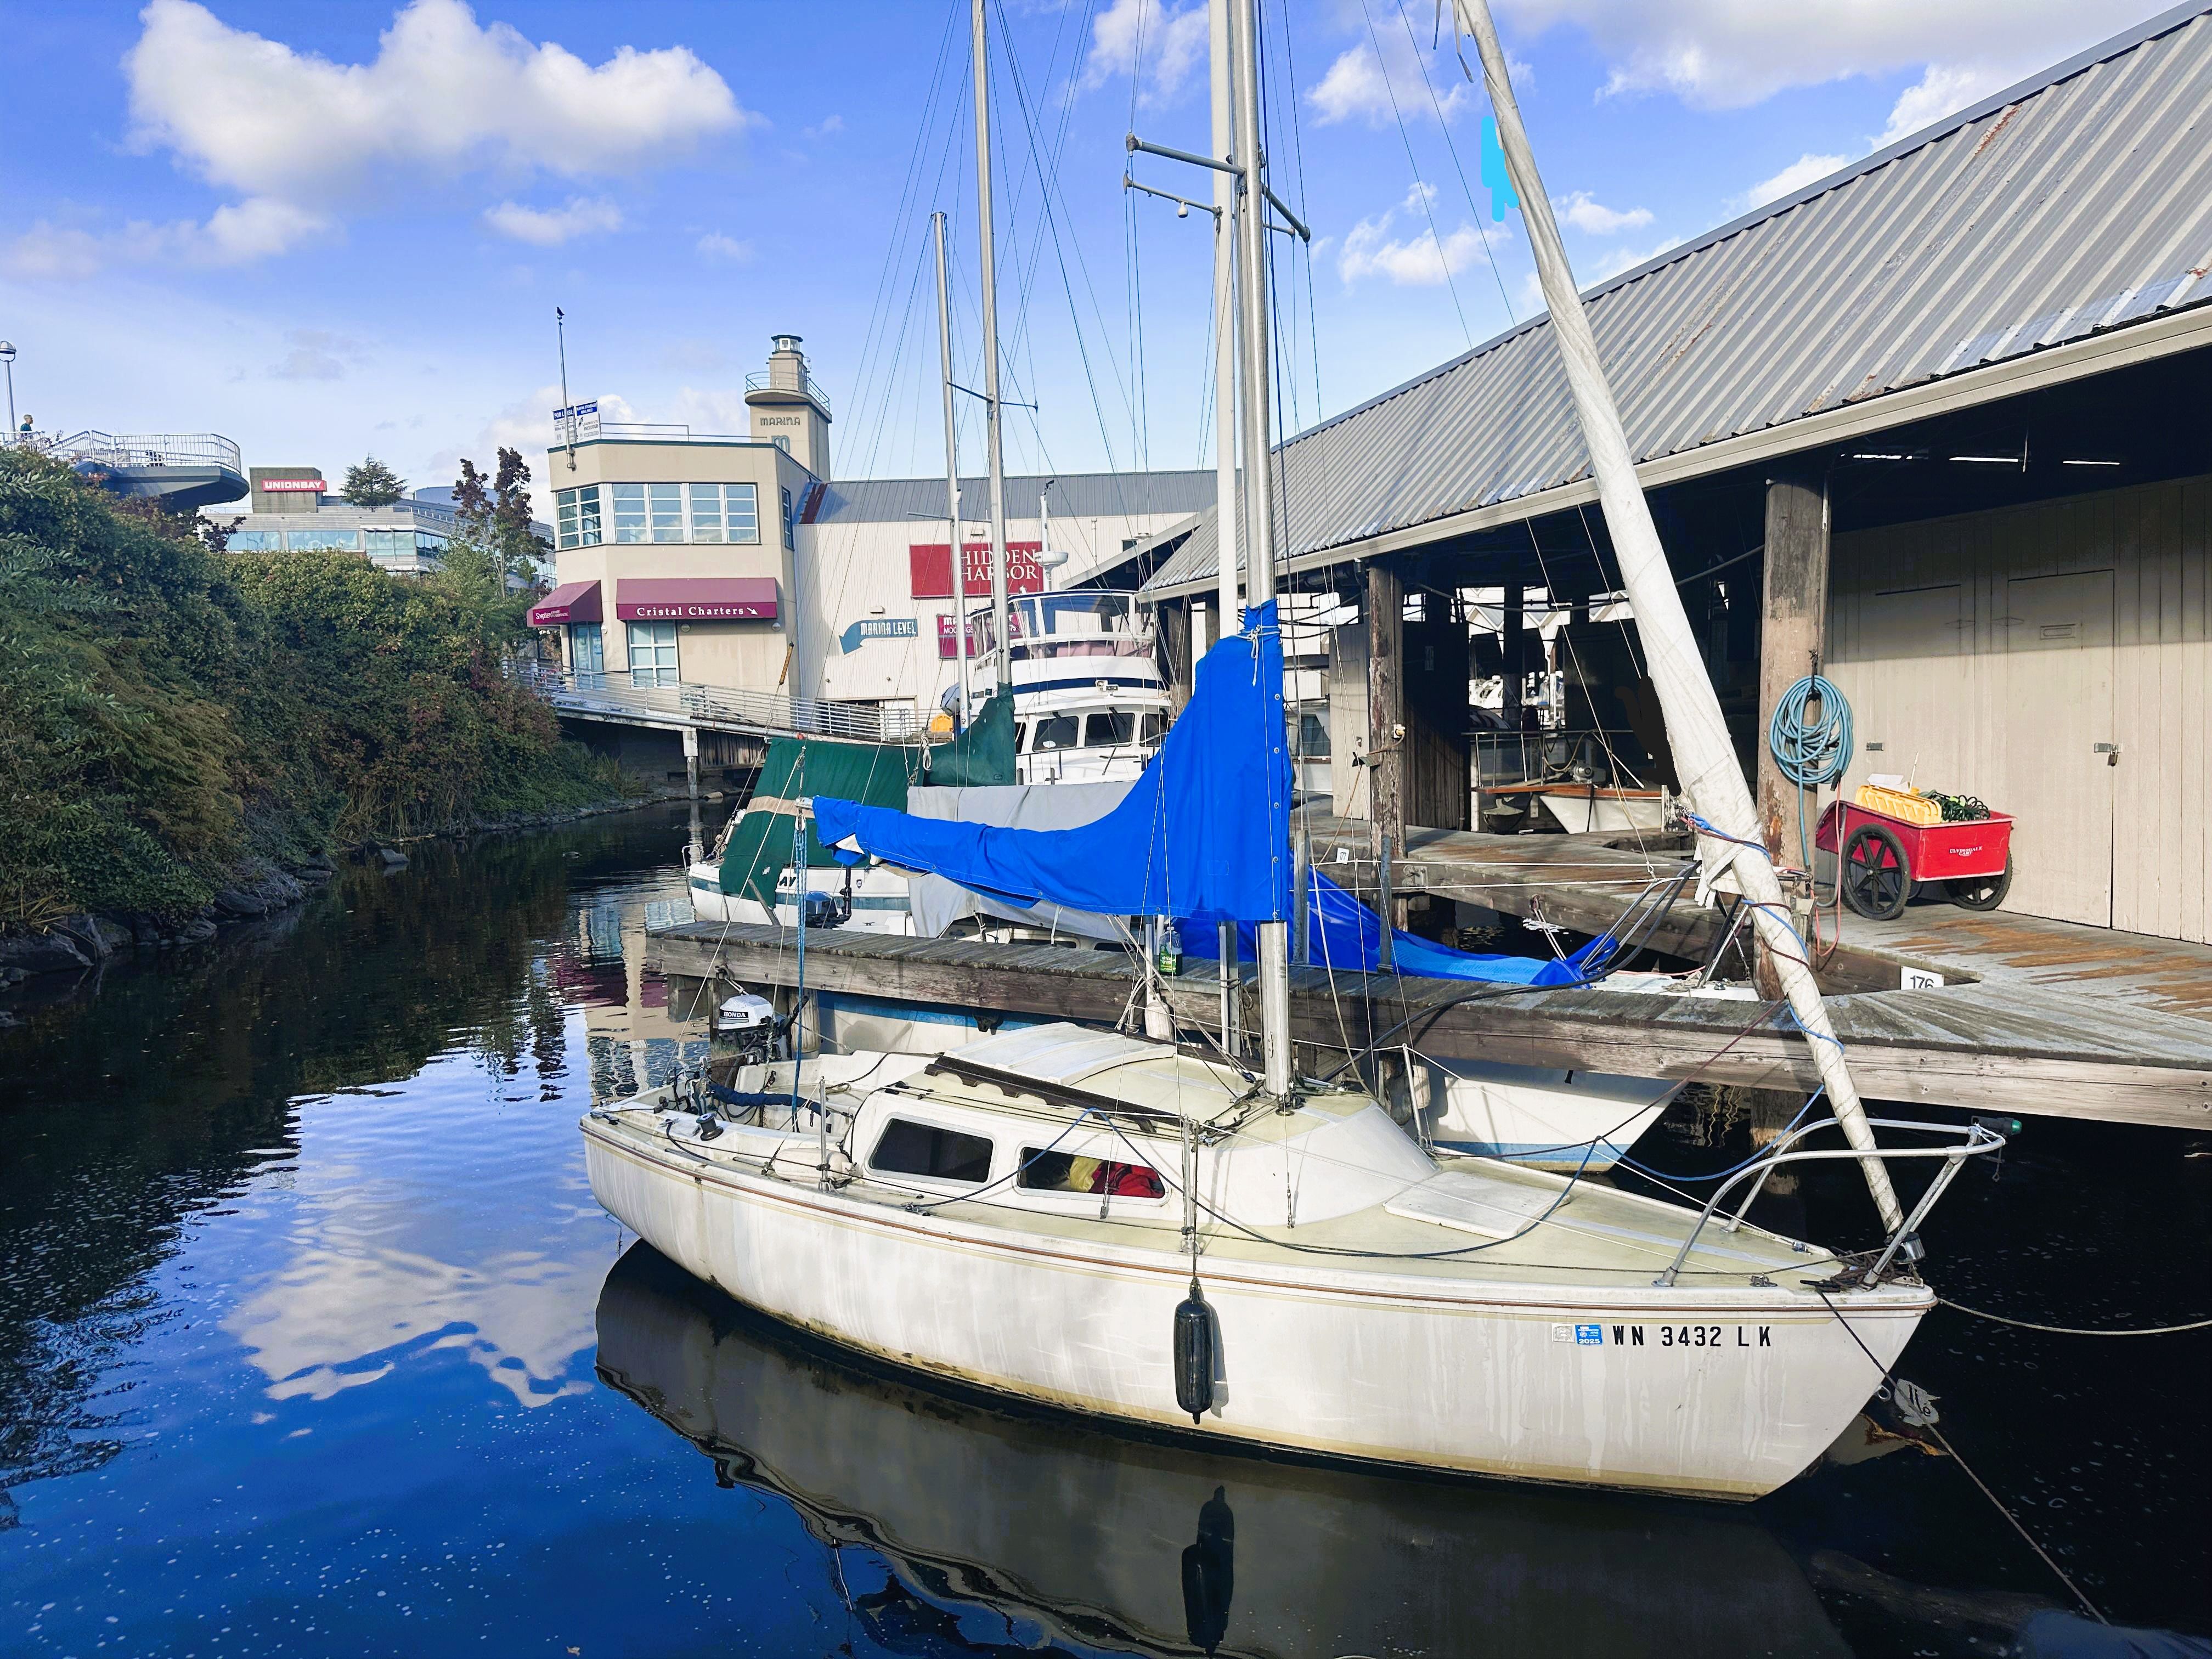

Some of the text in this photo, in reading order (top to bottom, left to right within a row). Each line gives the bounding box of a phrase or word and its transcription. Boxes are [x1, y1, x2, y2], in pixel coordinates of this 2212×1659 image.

[637, 607, 744, 616] Cristal Charters
[893, 622, 916, 635] LEVEL
[1910, 975, 1934, 989] 176
[1612, 1325, 1644, 1346] WN
[1661, 1326, 1722, 1347] 3432
[1737, 1326, 1771, 1347] LK
